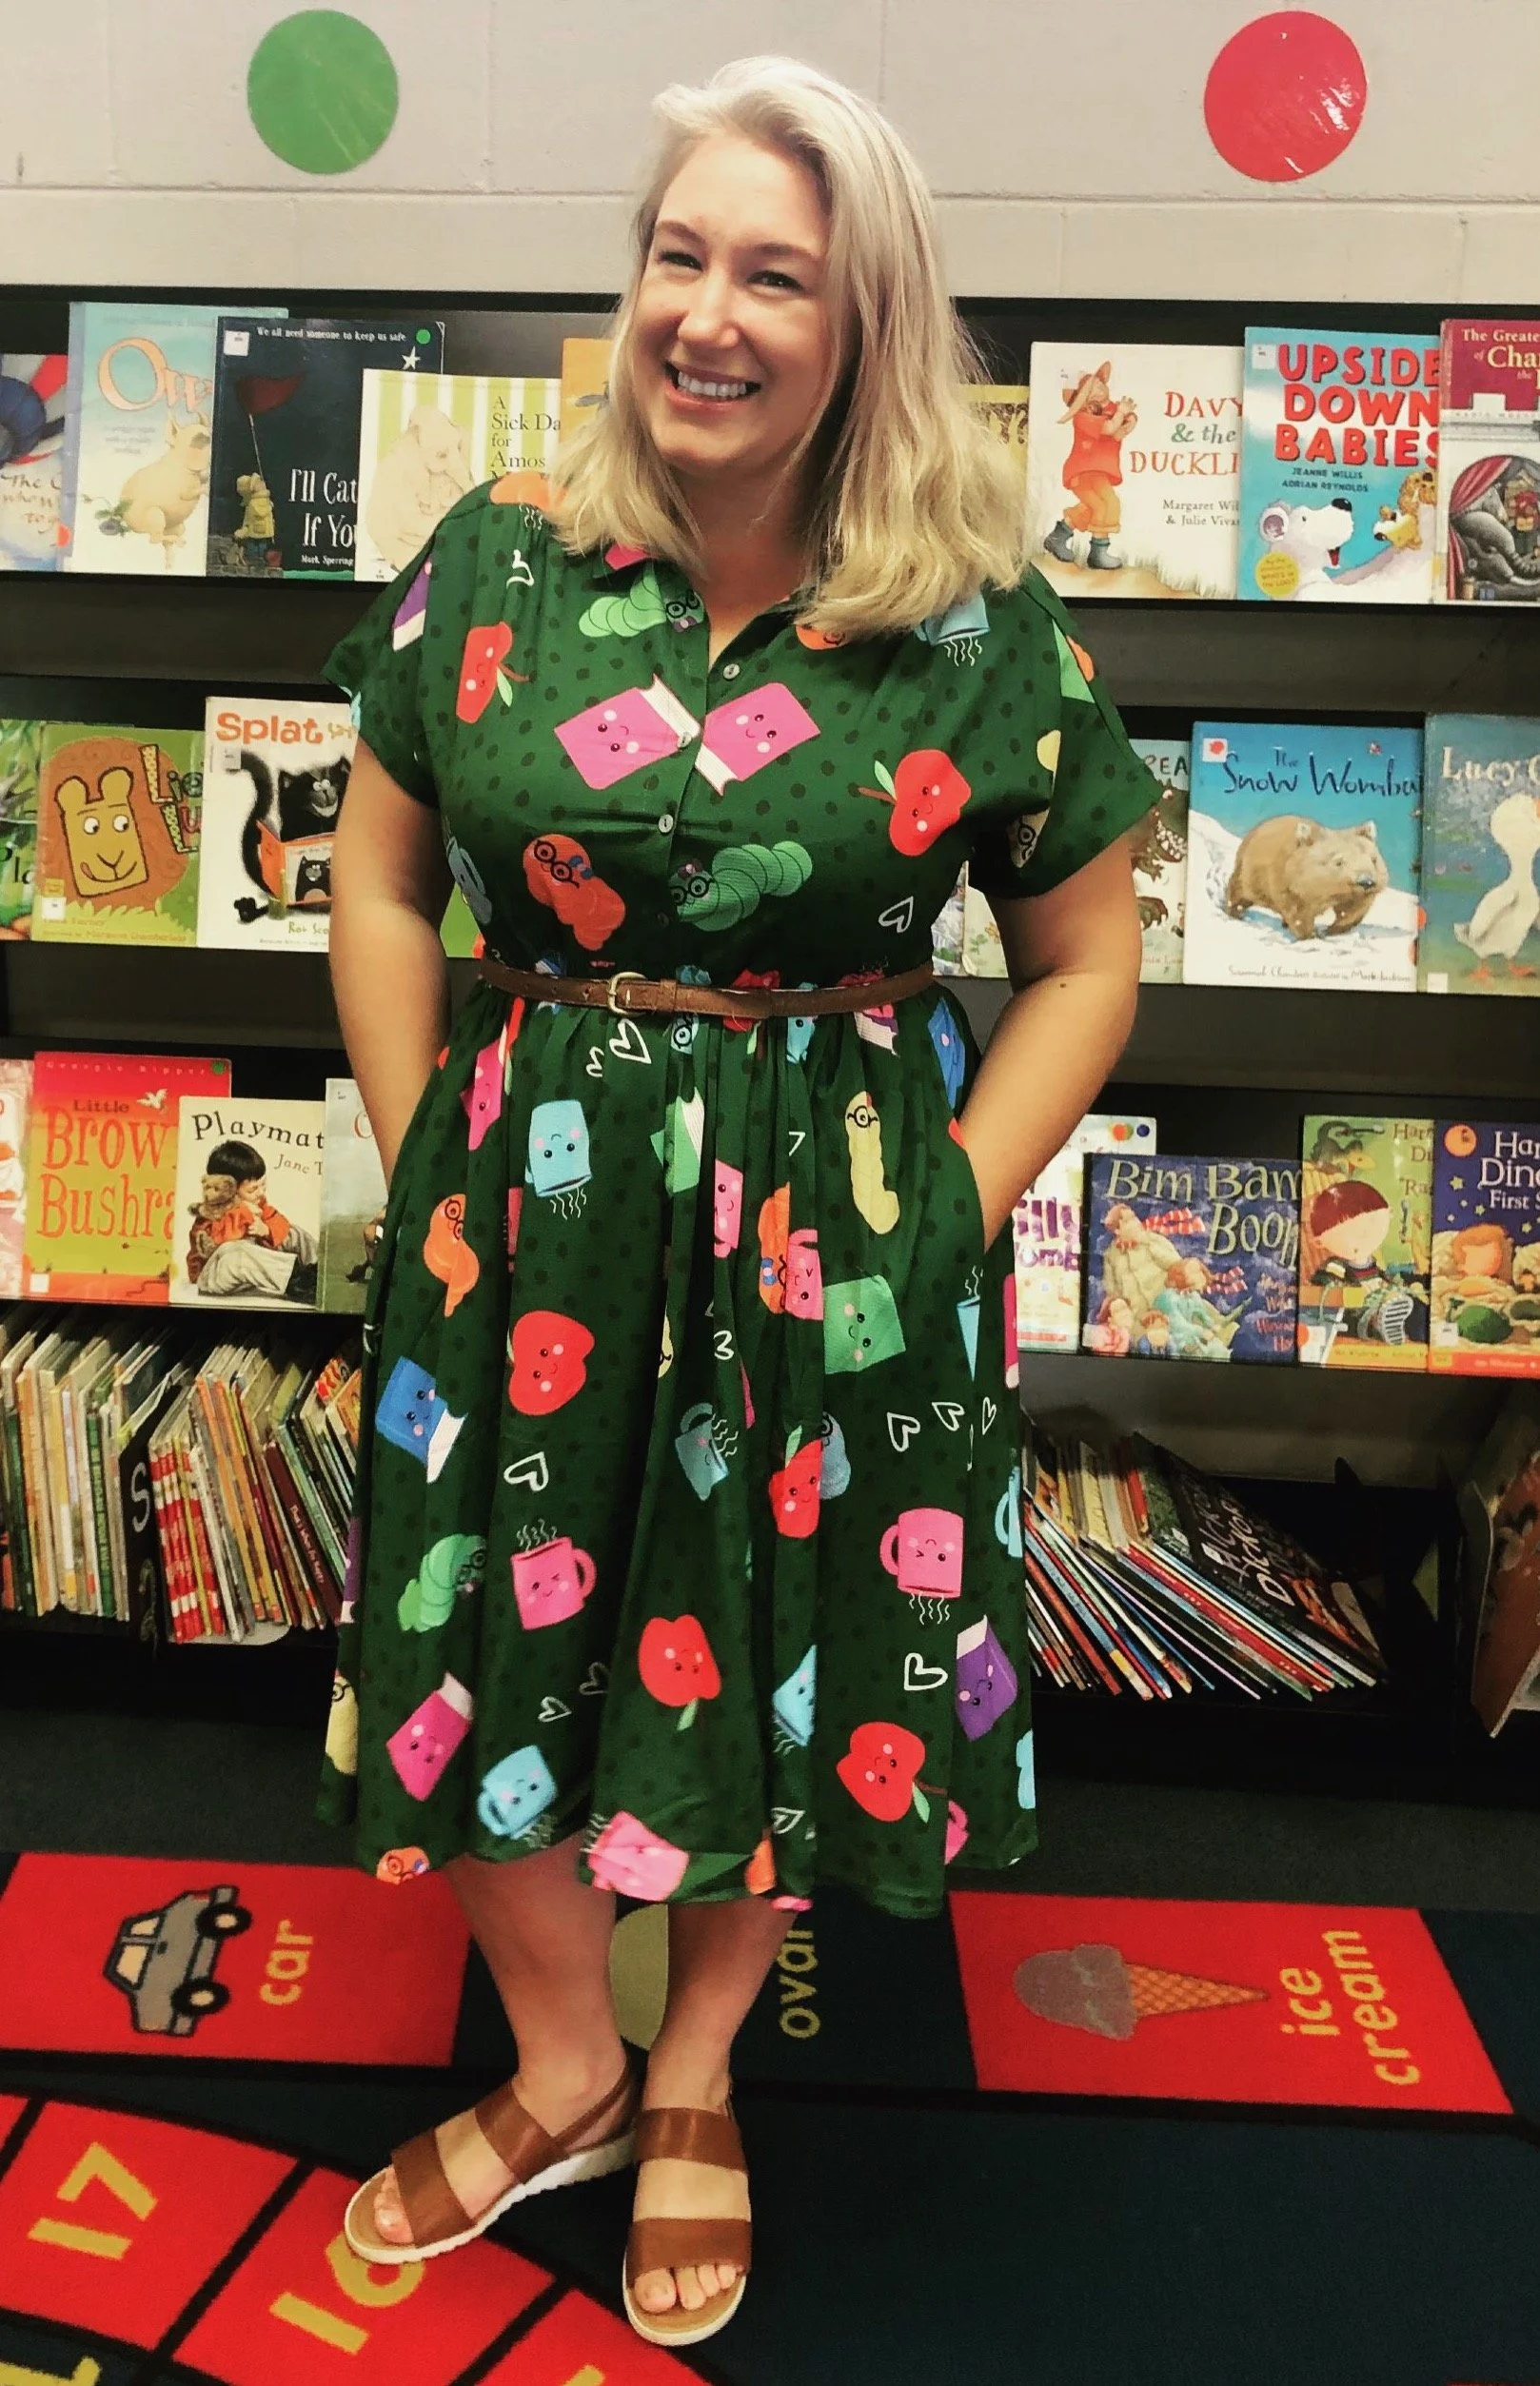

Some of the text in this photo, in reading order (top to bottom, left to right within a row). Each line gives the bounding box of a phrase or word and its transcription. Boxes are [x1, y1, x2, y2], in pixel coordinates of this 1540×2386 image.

[256, 326, 406, 343] We all need someone to keep us safe
[1462, 328, 1488, 342] The
[1277, 343, 1440, 387] UPSIDE
[493, 396, 506, 410] A
[1164, 391, 1243, 419] DAVY
[1283, 383, 1439, 427] DOWN
[491, 413, 562, 431] Sick Da
[491, 433, 512, 447] for
[1171, 423, 1237, 444] & the
[490, 450, 546, 468] Amos
[1292, 467, 1364, 480] JEANNE WILLIS
[288, 467, 316, 503] I'll
[1281, 480, 1369, 493] ADRIAN REYNOLDS
[1162, 499, 1214, 512] Margaret
[303, 513, 323, 547] If
[1165, 514, 1176, 525] &
[1181, 514, 1207, 526] Julie
[301, 555, 355, 567] Mark Sperring
[216, 712, 324, 745] Splat
[1223, 751, 1298, 794] Snow
[72, 1098, 130, 1115] Little
[42, 1104, 178, 1171] Brow
[274, 1154, 309, 1174] Jane
[1105, 1158, 1194, 1204] Bim
[1490, 1190, 1530, 1210] First
[131, 1462, 150, 1532] S
[259, 1919, 315, 2006] car
[1278, 1967, 1341, 2037] ice
[1321, 1929, 1421, 2086] cream
[28, 2141, 159, 2261] 17
